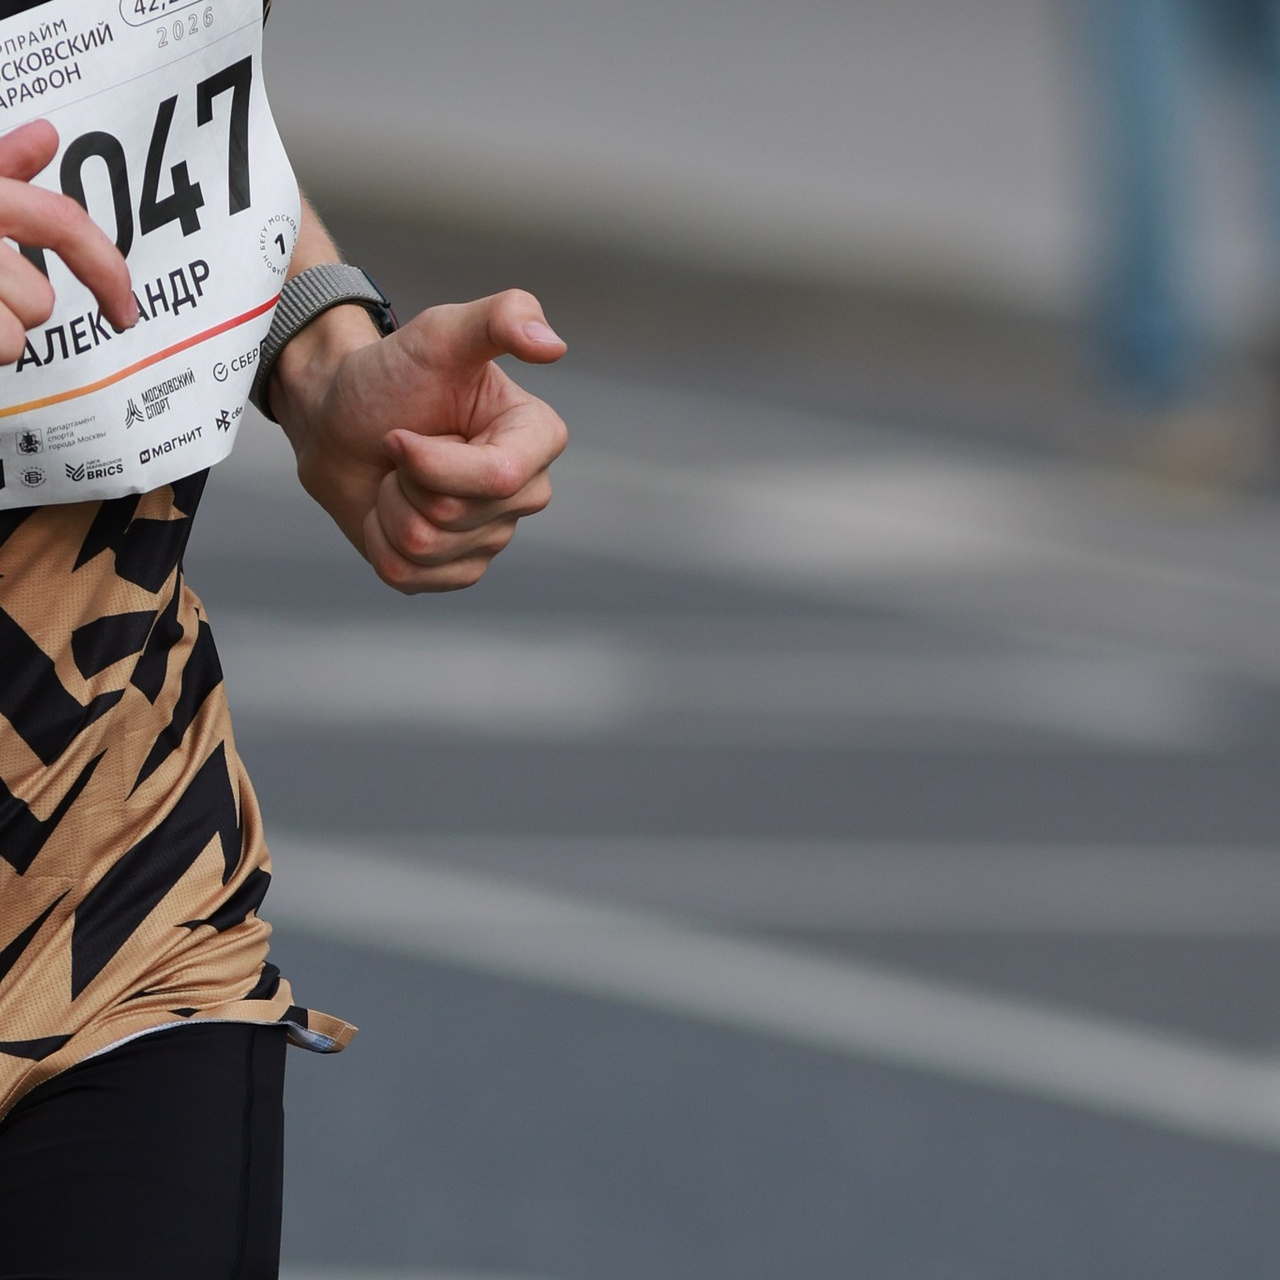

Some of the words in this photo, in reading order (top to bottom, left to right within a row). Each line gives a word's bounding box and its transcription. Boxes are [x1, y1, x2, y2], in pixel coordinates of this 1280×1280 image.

[156, 6, 214, 48] 2026
[18, 54, 252, 282] 047
[260, 226, 268, 250] БЕГУ
[274, 232, 286, 256] 1
[15, 259, 210, 373] АЛЕКНДР
[231, 347, 259, 372] СБЕР
[141, 367, 196, 406] МОСКОВСКИЙ
[145, 397, 171, 420] СПОРТ
[46, 415, 96, 435] Департамент
[47, 431, 74, 443] спорта
[48, 440, 76, 451] города
[77, 431, 107, 444] Москвы
[152, 426, 203, 459] магнит
[87, 463, 124, 480] BRICS
